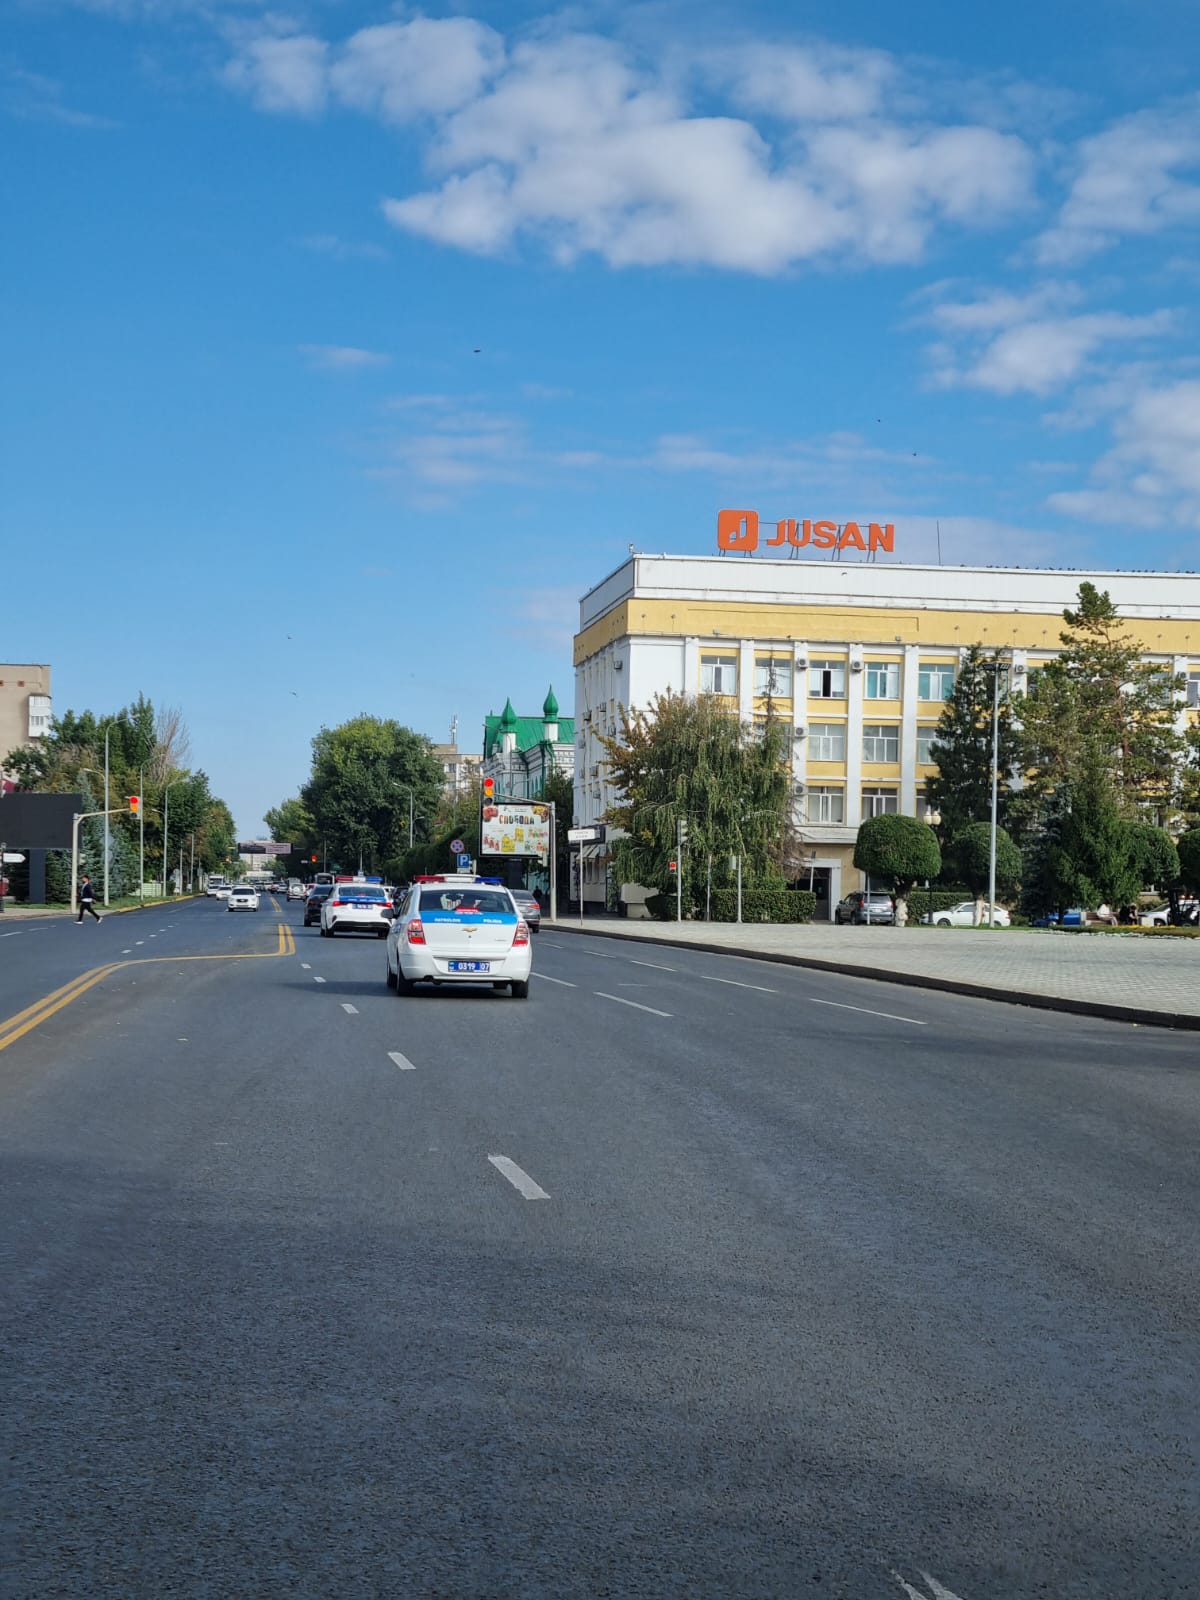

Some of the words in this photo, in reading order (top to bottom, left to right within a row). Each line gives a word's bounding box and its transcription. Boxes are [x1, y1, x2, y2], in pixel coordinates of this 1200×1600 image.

[766, 519, 895, 552] JUSAN
[460, 855, 469, 866] P
[457, 962, 476, 970] 0319
[480, 962, 490, 970] 07
